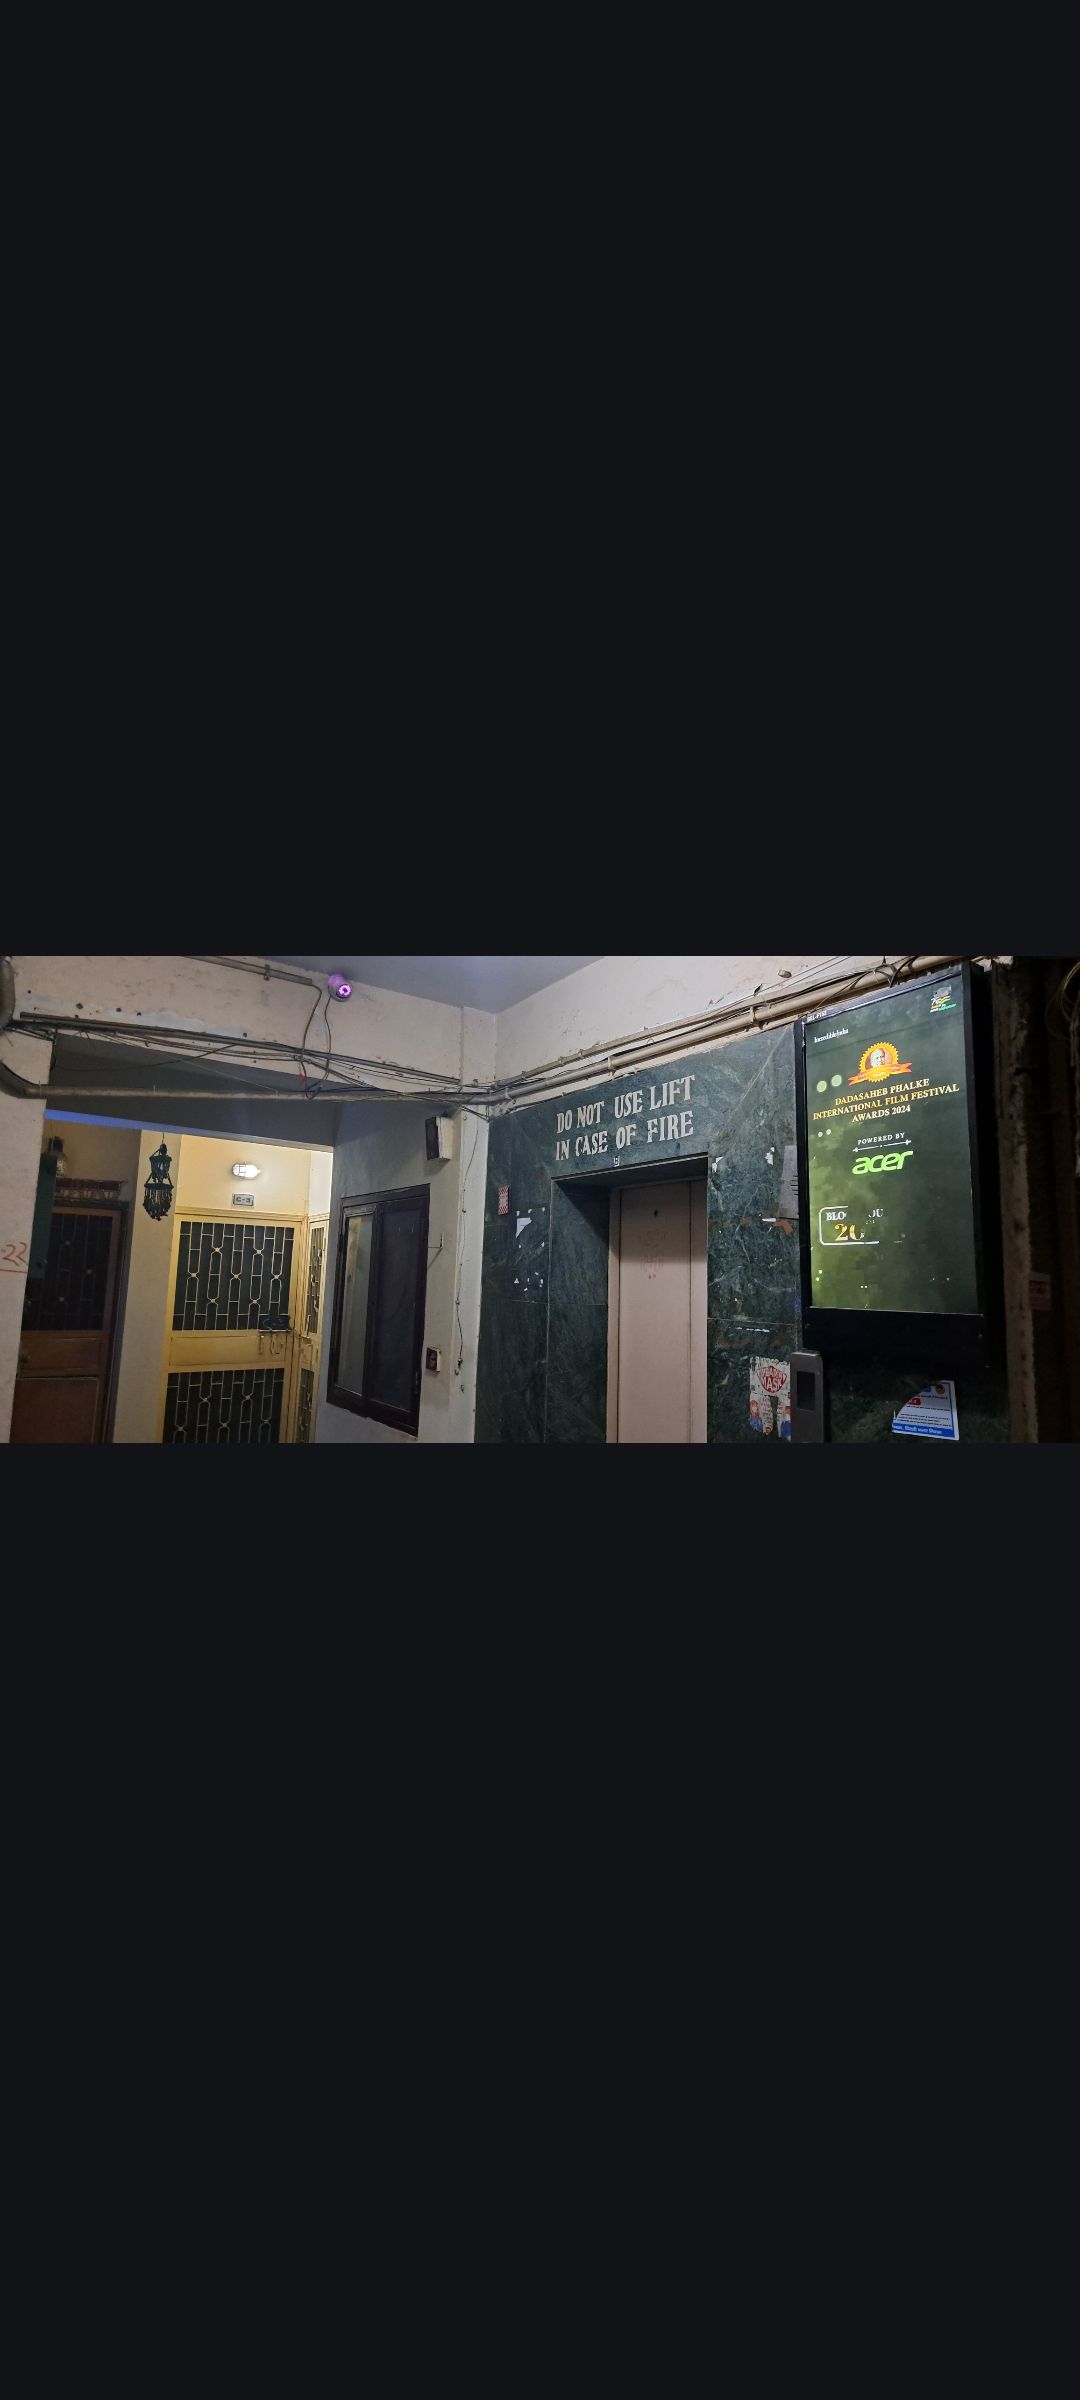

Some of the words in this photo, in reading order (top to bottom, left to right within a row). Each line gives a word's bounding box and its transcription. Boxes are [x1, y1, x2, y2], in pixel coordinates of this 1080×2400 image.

[556, 1109, 573, 1134] DO
[576, 1101, 605, 1129] NOT
[614, 1090, 643, 1119] USE
[648, 1074, 696, 1111] LIFT
[812, 1099, 883, 1120] INTERNATIONAL
[885, 1092, 909, 1106] FILM
[911, 1083, 960, 1101] FESTIVAL
[834, 1088, 888, 1106] DADASAHEB
[890, 1078, 930, 1094] PHALKE
[851, 1107, 890, 1123] AWARDS
[891, 1104, 911, 1116] 2024
[555, 1139, 570, 1161] IN
[575, 1130, 608, 1157] CASE
[615, 1123, 637, 1149] OF
[646, 1110, 694, 1143] FIRE
[857, 1134, 893, 1146] POWERED
[895, 1132, 906, 1140] BY
[851, 1150, 914, 1175] acer
